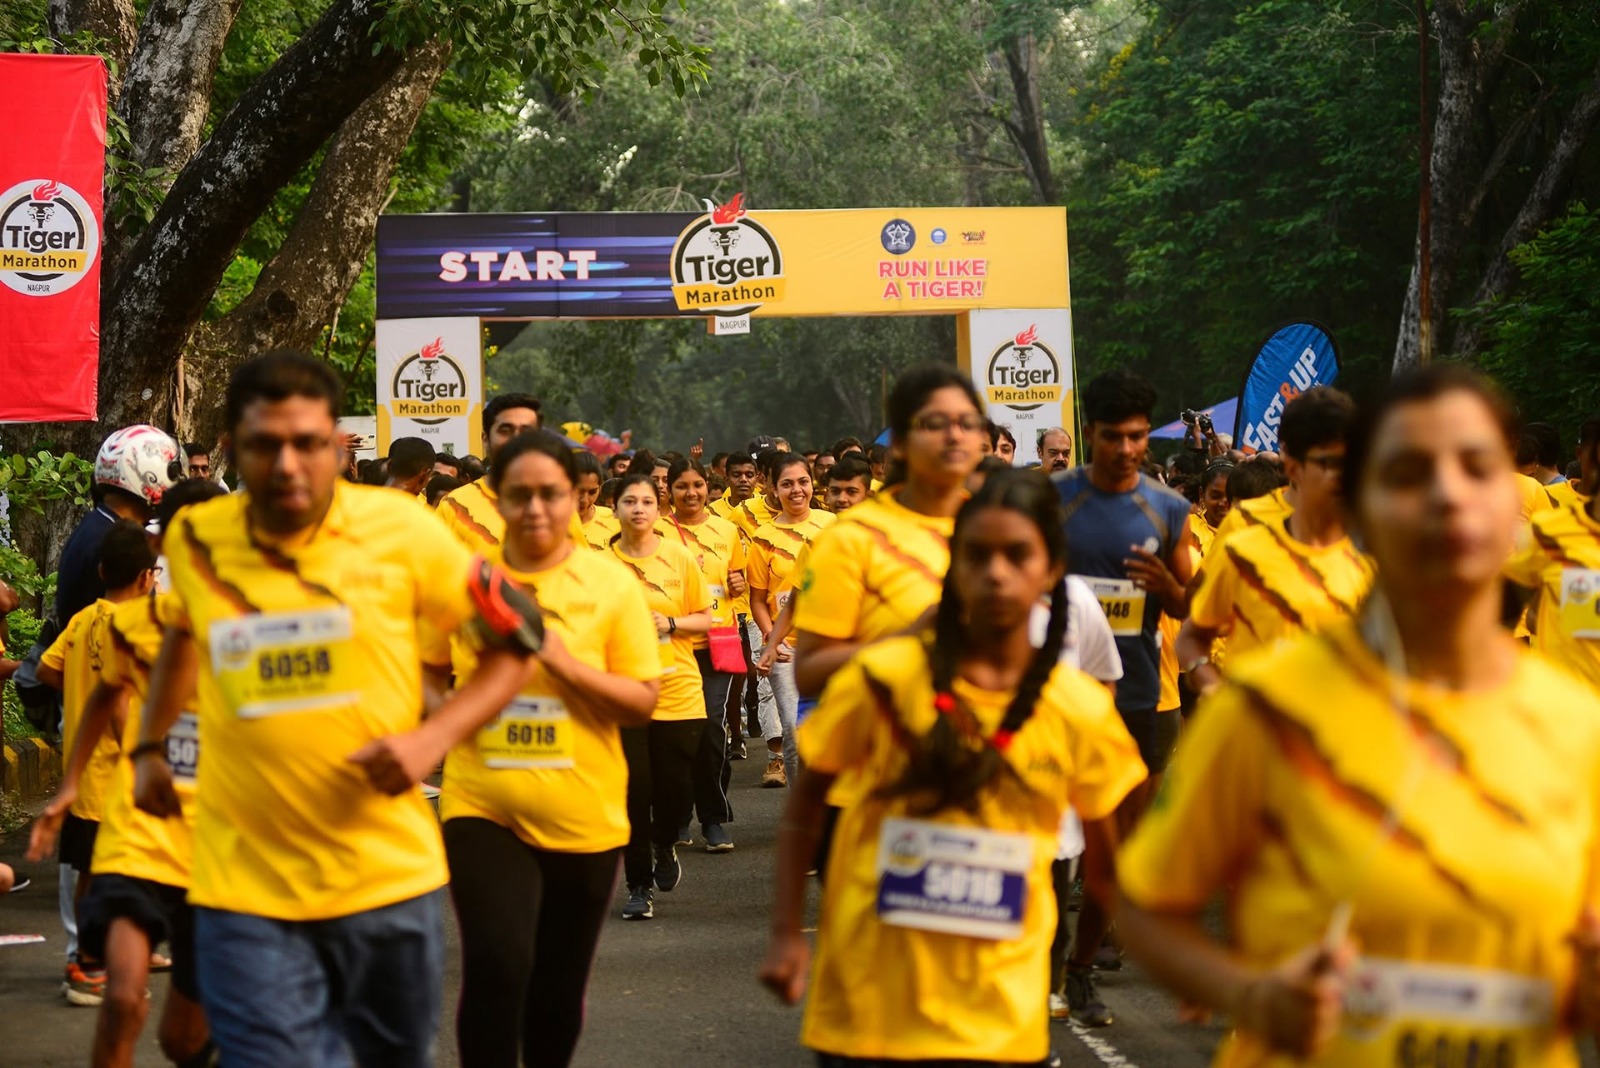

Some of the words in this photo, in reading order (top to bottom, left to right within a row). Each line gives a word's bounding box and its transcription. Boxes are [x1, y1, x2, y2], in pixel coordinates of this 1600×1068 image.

[6, 225, 76, 254] Tiger
[2, 254, 78, 269] Marathon
[438, 250, 598, 283] START
[685, 255, 770, 286] Tiger
[878, 260, 928, 278] RUN
[935, 259, 986, 276] LIKE
[27, 284, 51, 293] NAGPUR
[685, 285, 776, 305] Marathon
[883, 281, 901, 299] A
[906, 280, 983, 298] TIGER!
[719, 320, 748, 330] NAGPUR
[995, 366, 1053, 388] Tiger
[400, 379, 459, 402] Tiger
[994, 389, 1055, 401] Marathon
[399, 402, 461, 414] Marathon
[1015, 413, 1035, 421] NAGPUR
[1099, 600, 1131, 619] 148
[259, 648, 332, 681] 6058
[507, 723, 556, 745] 6018
